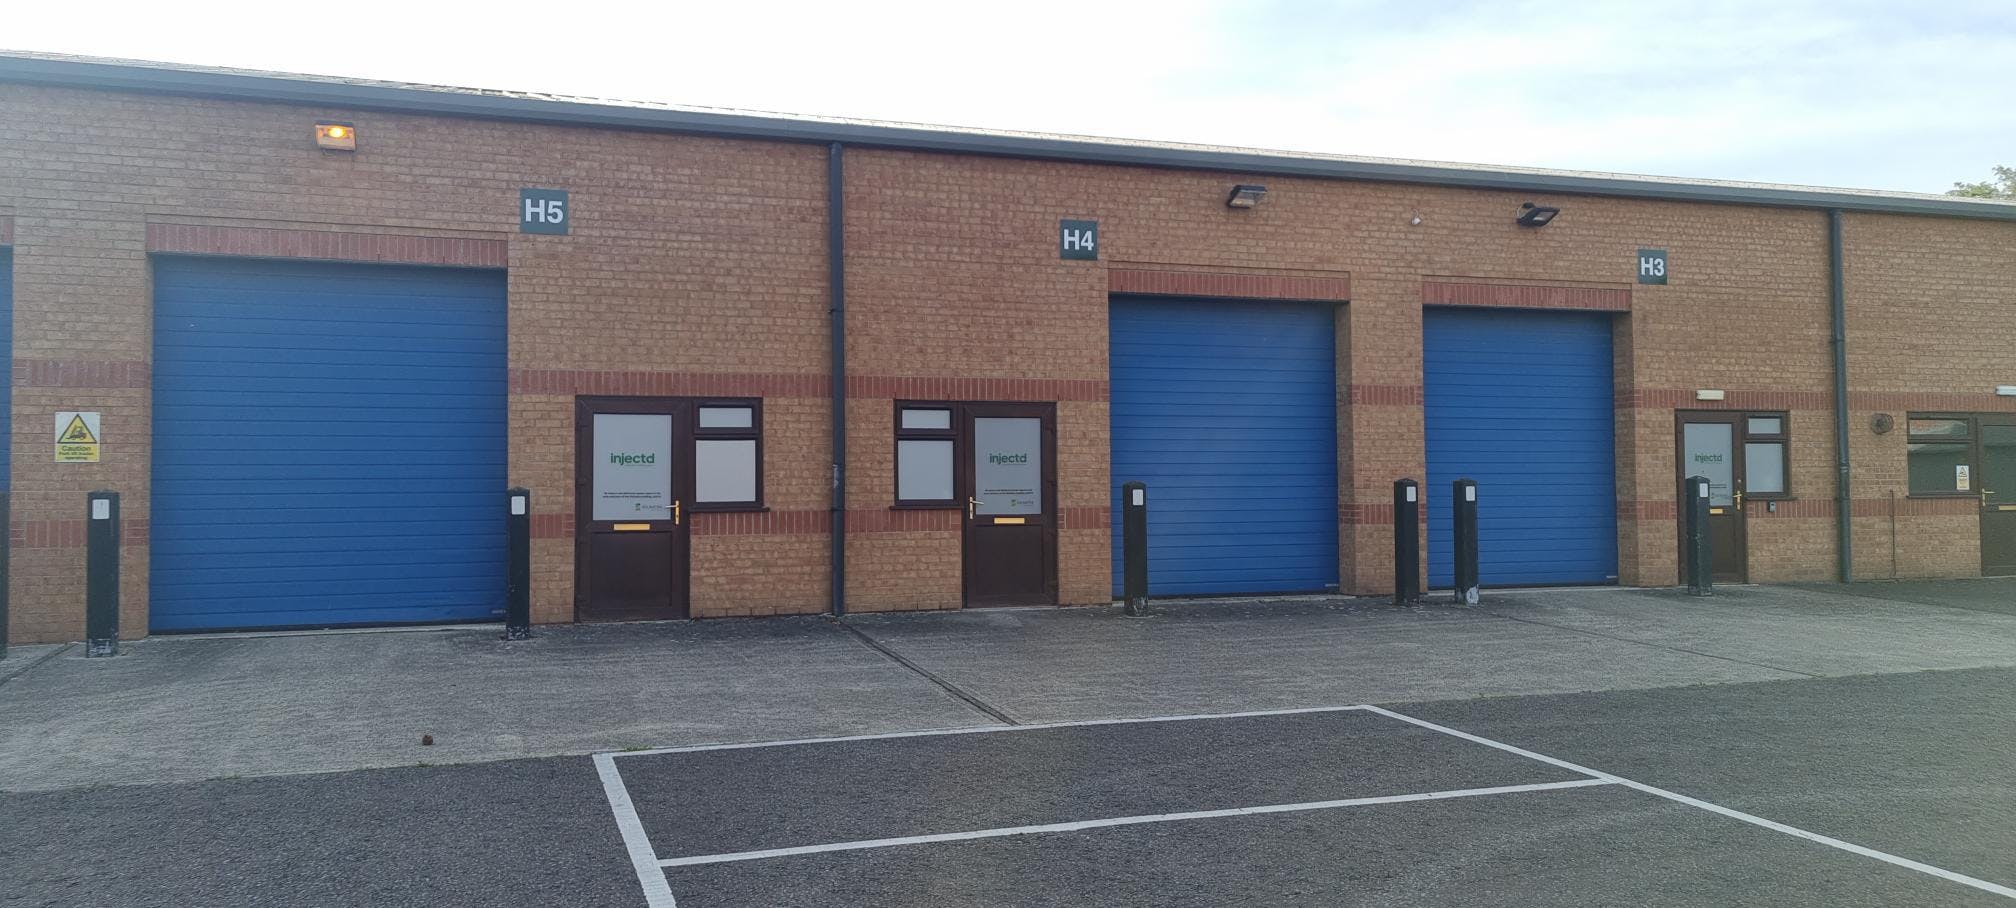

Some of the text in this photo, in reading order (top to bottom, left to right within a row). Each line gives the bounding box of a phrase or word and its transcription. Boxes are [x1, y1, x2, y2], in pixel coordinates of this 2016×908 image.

[525, 198, 564, 224] H5
[1063, 228, 1095, 251] H4
[1640, 256, 1665, 277] H3
[609, 452, 656, 466] injectd
[989, 452, 1028, 465] injectd
